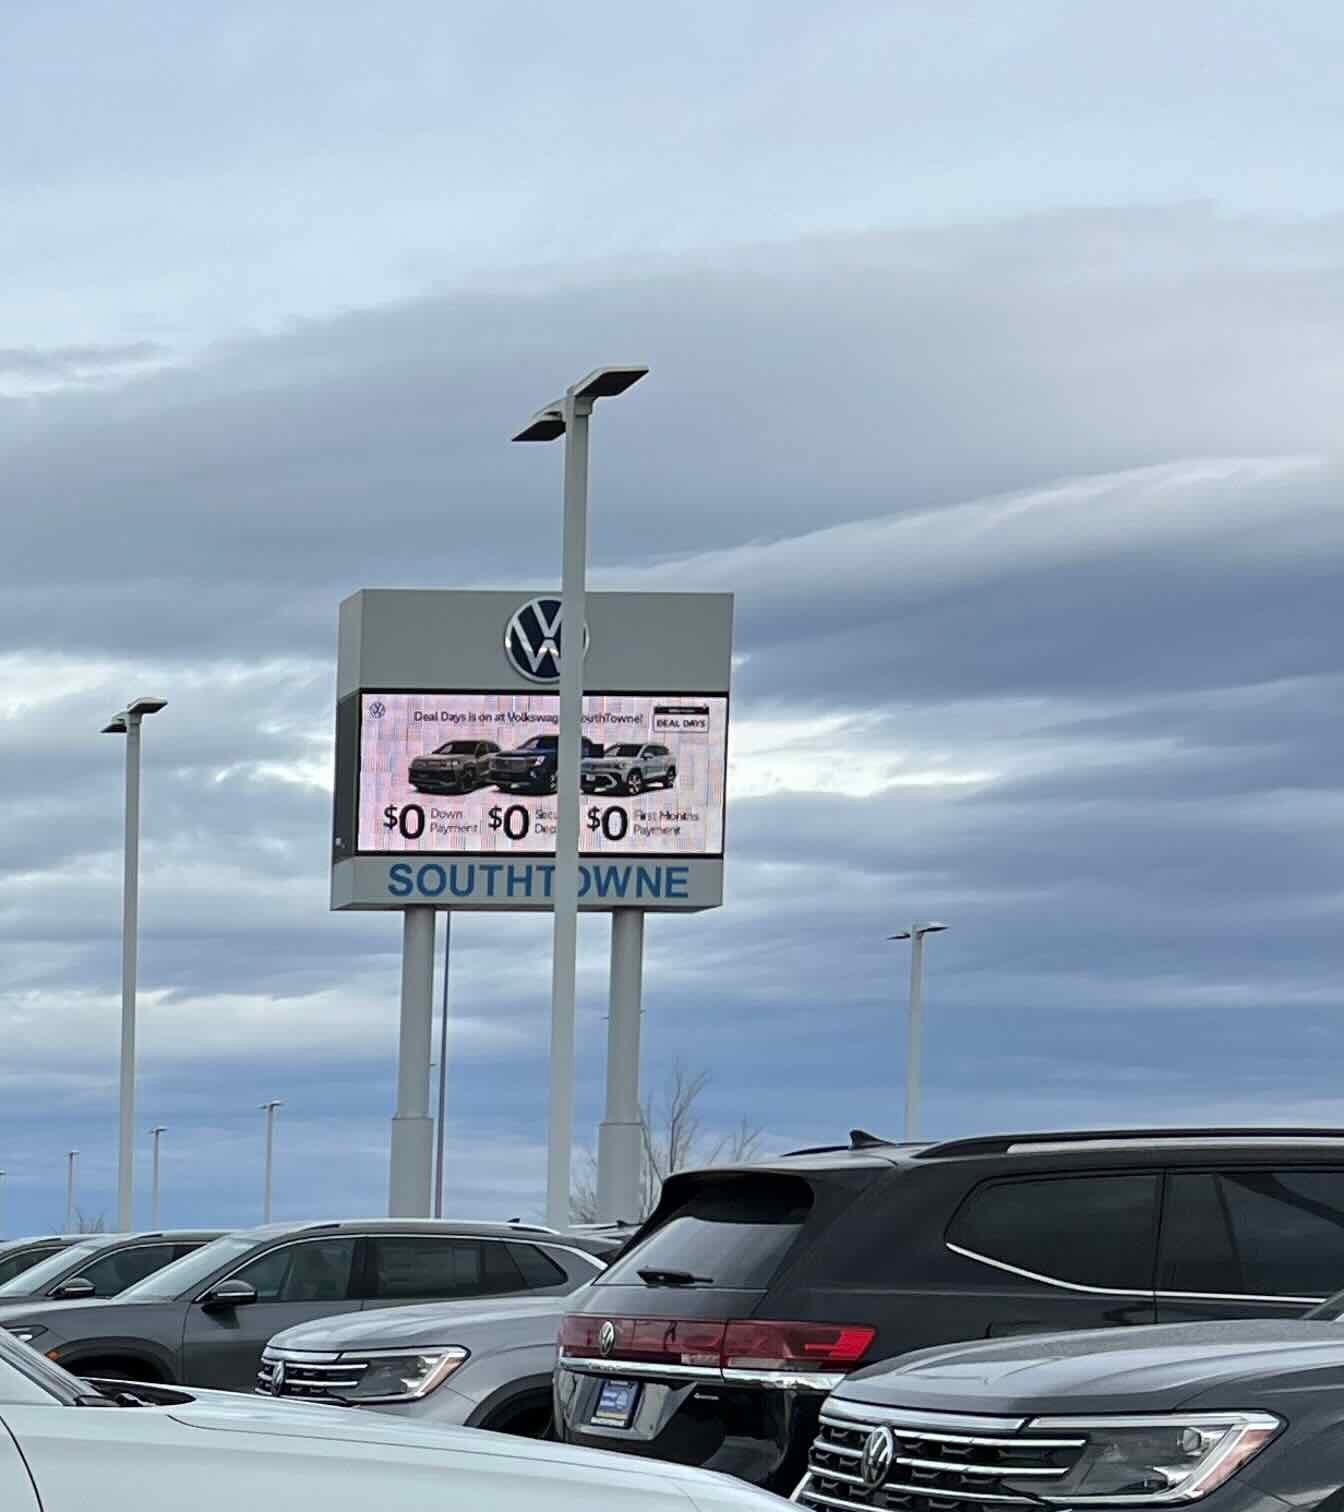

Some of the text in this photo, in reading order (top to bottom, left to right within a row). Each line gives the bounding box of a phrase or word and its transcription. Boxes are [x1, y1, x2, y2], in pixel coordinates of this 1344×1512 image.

[414, 711, 438, 722] Deal
[441, 711, 466, 724] Days
[468, 711, 476, 722] is
[478, 713, 492, 722] on
[494, 712, 505, 722] at
[507, 711, 559, 725] Volkswag
[656, 719, 705, 728] DEAL DAYS
[430, 808, 462, 820] Down
[384, 804, 425, 840] $0
[488, 805, 529, 841] $0
[587, 806, 628, 841] $0
[430, 823, 478, 836] Payment
